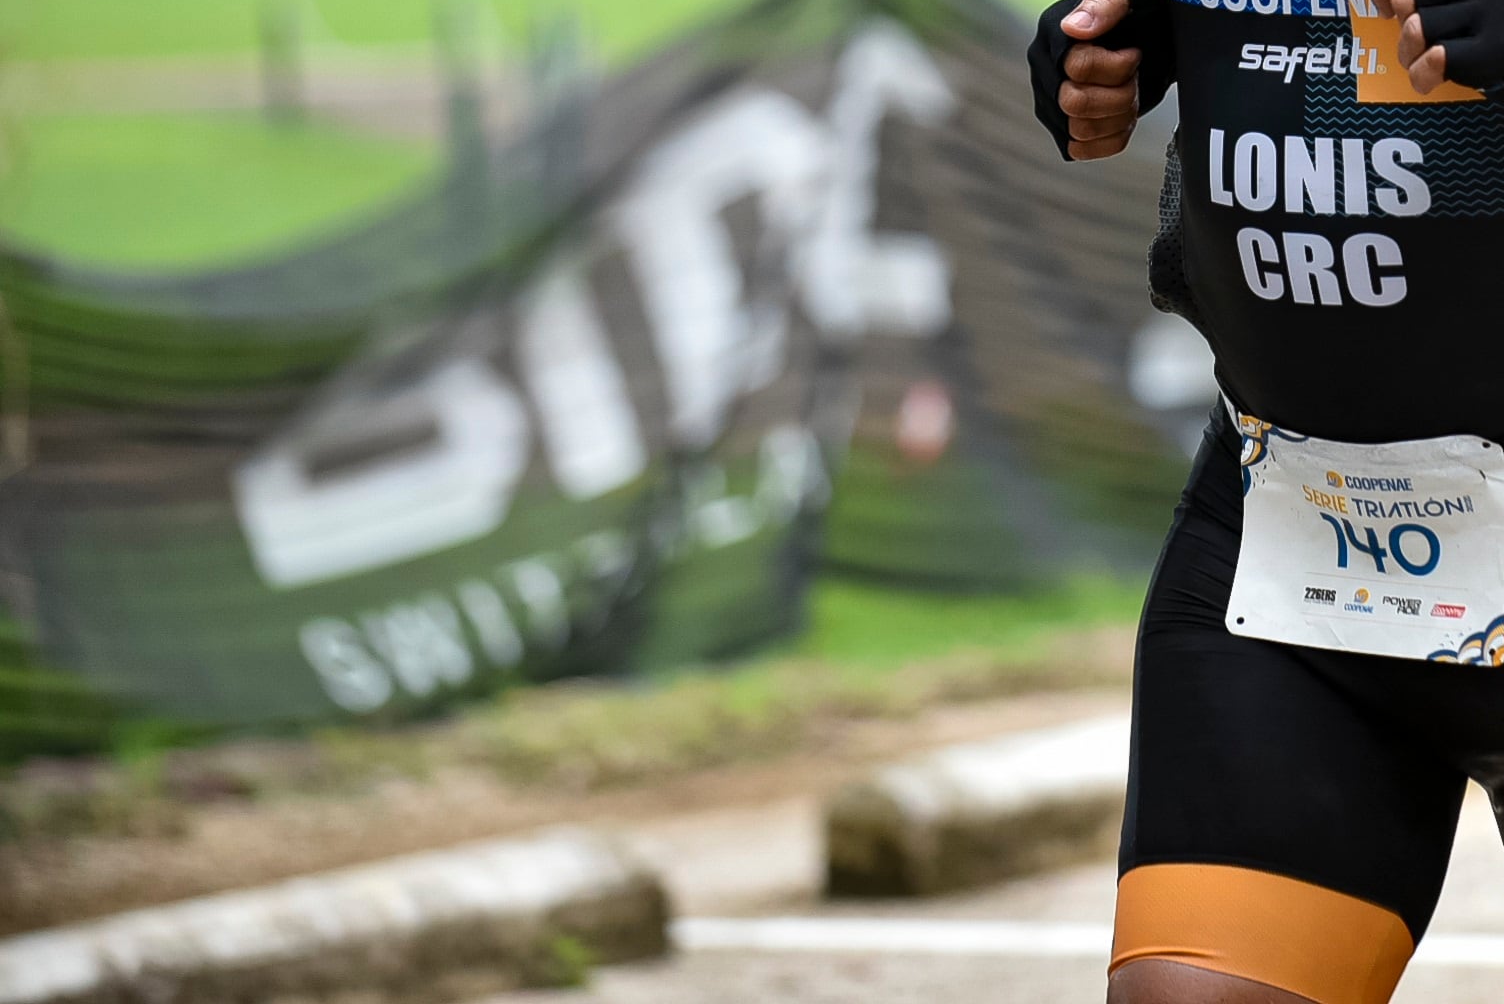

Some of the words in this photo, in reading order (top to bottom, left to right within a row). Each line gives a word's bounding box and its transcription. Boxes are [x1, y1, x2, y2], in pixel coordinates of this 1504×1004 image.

[1209, 128, 1431, 217] LONIS
[1236, 227, 1407, 307] CRC
[1302, 484, 1348, 514] SERIE
[1351, 497, 1465, 518] TRIATLÓN
[1344, 475, 1414, 492] COOPENAE
[1319, 512, 1441, 576] 140
